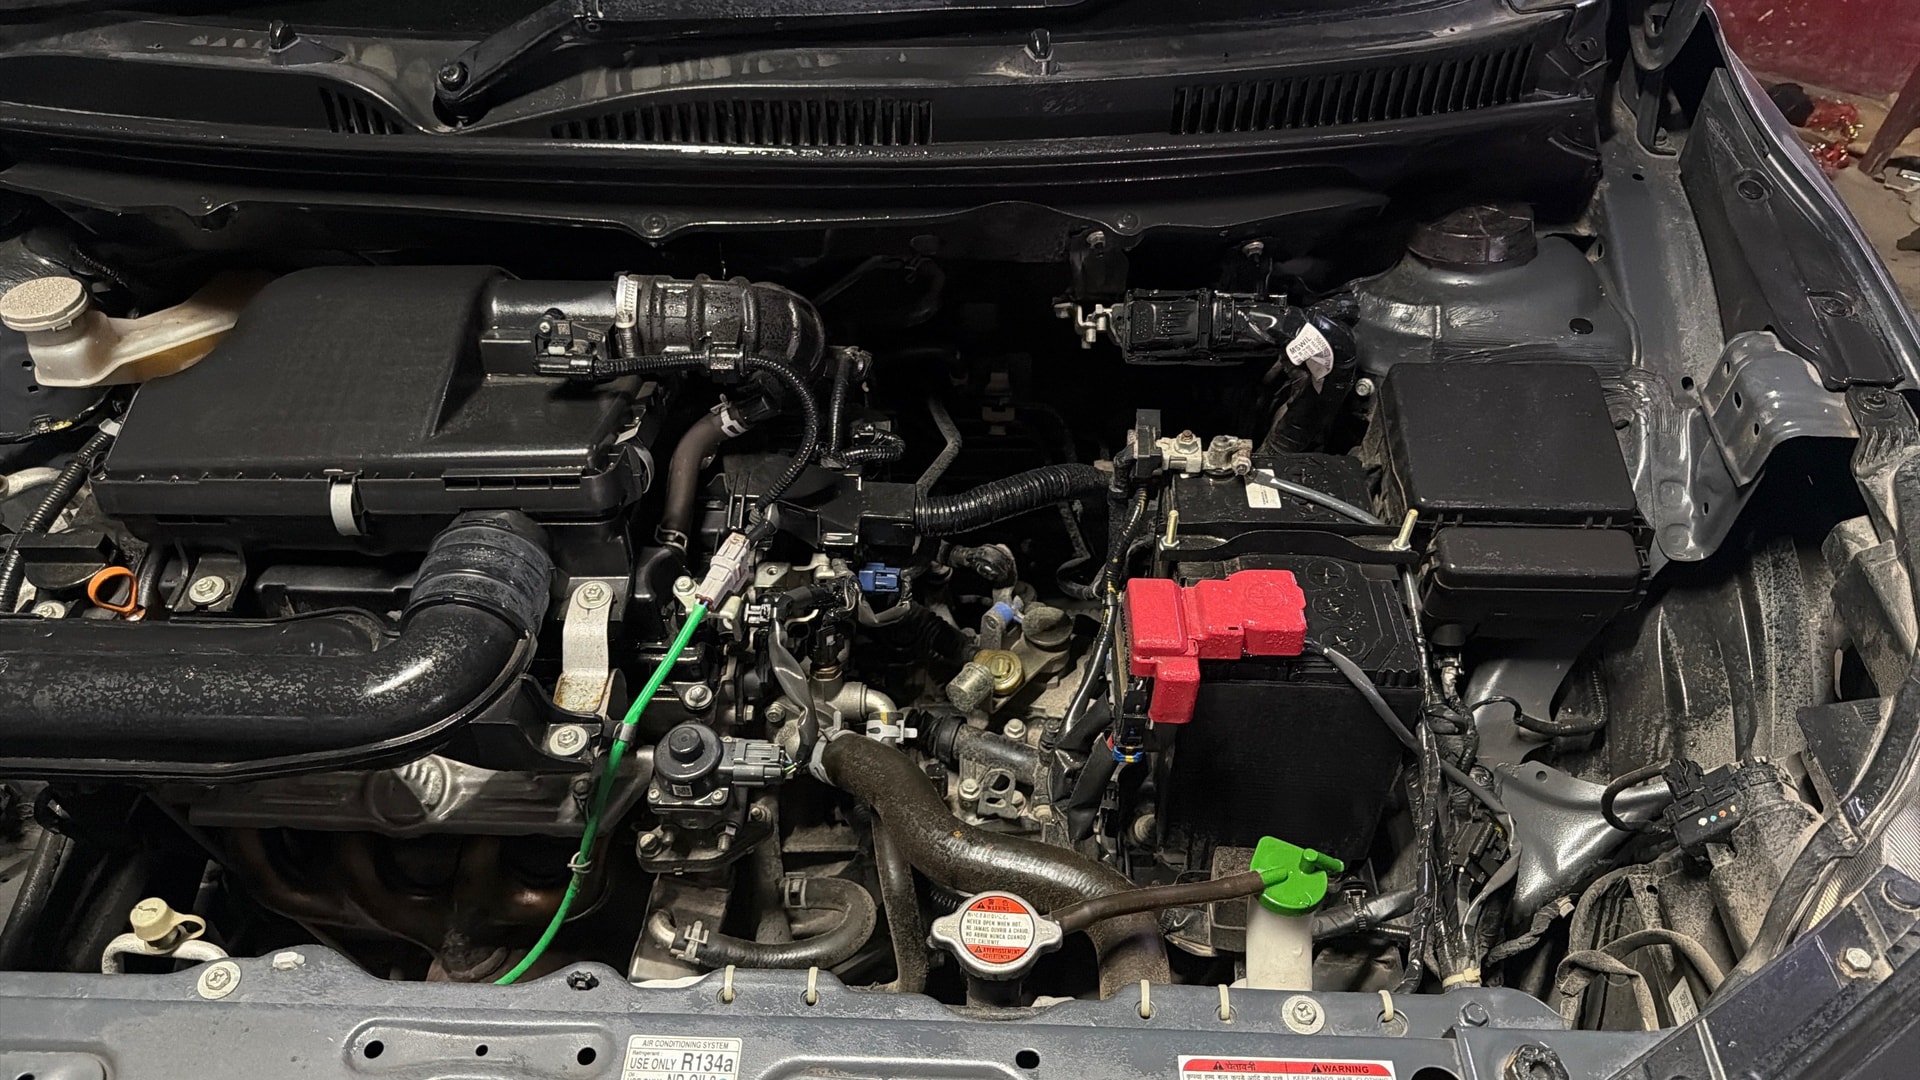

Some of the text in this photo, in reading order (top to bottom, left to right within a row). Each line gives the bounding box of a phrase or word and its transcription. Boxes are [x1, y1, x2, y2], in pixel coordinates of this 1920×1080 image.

[1289, 336, 1312, 354] MSWIL
[642, 1039, 729, 1049] AIR CONDITIONING SYSTEM
[630, 1052, 734, 1072] USE ONLY R134a
[1322, 1064, 1369, 1074] WARNING
